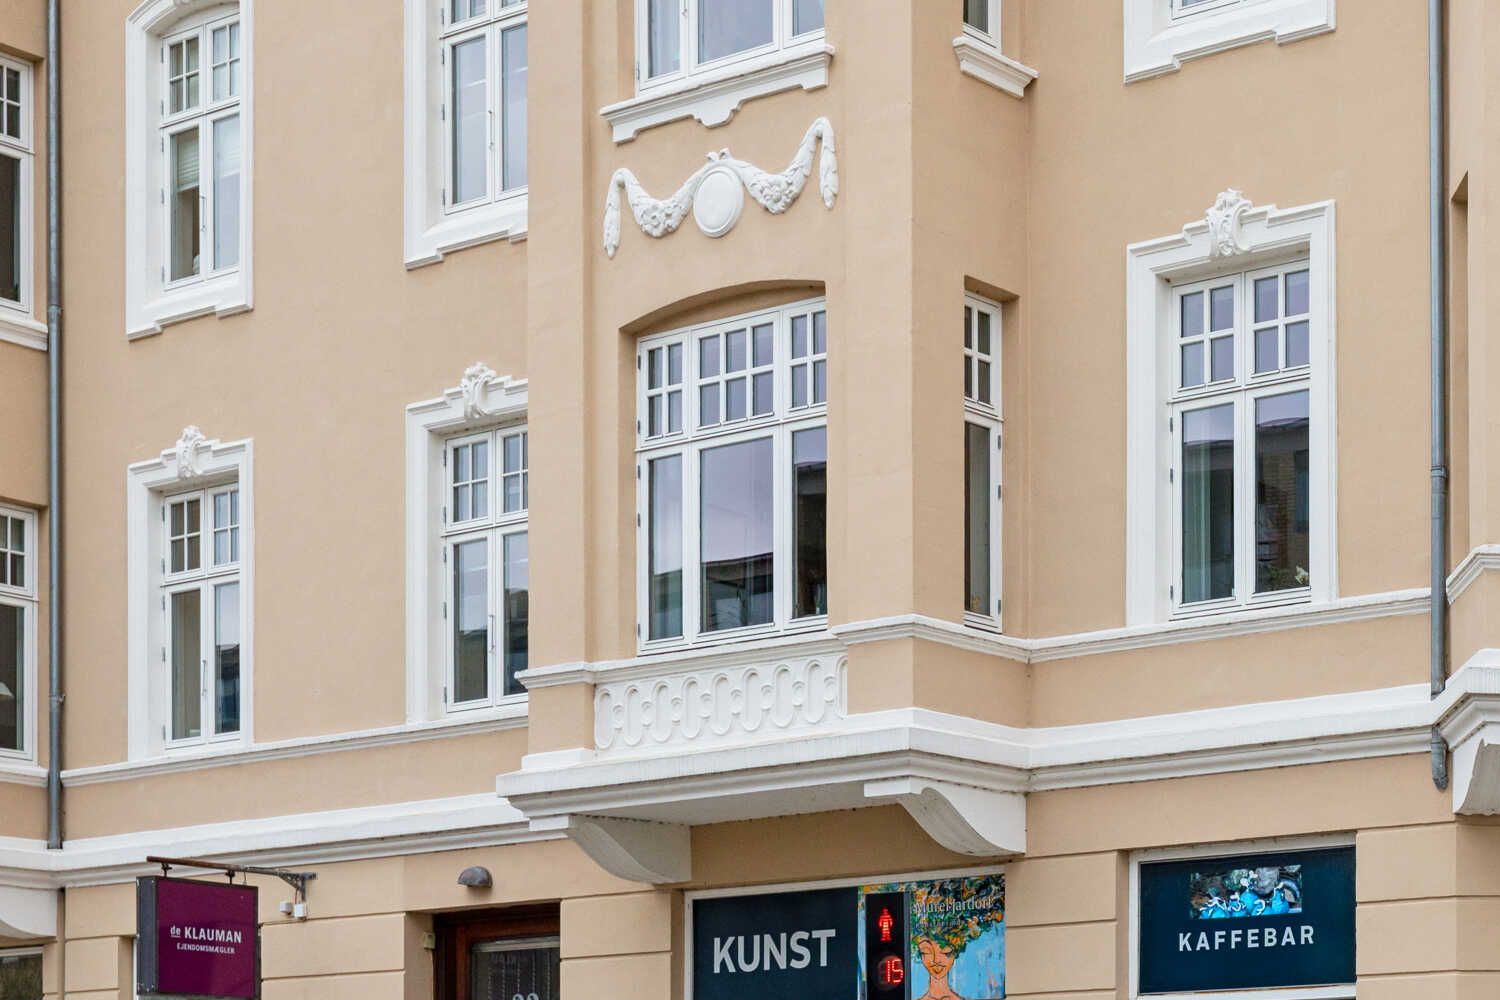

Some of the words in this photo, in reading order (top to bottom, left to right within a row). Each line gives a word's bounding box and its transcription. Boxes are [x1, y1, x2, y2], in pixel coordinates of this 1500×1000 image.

[170, 925, 181, 936] de
[184, 926, 242, 943] KLAUMAN
[1178, 925, 1315, 952] KAFFEBAR
[713, 928, 836, 974] KUNST
[886, 958, 904, 984] 15
